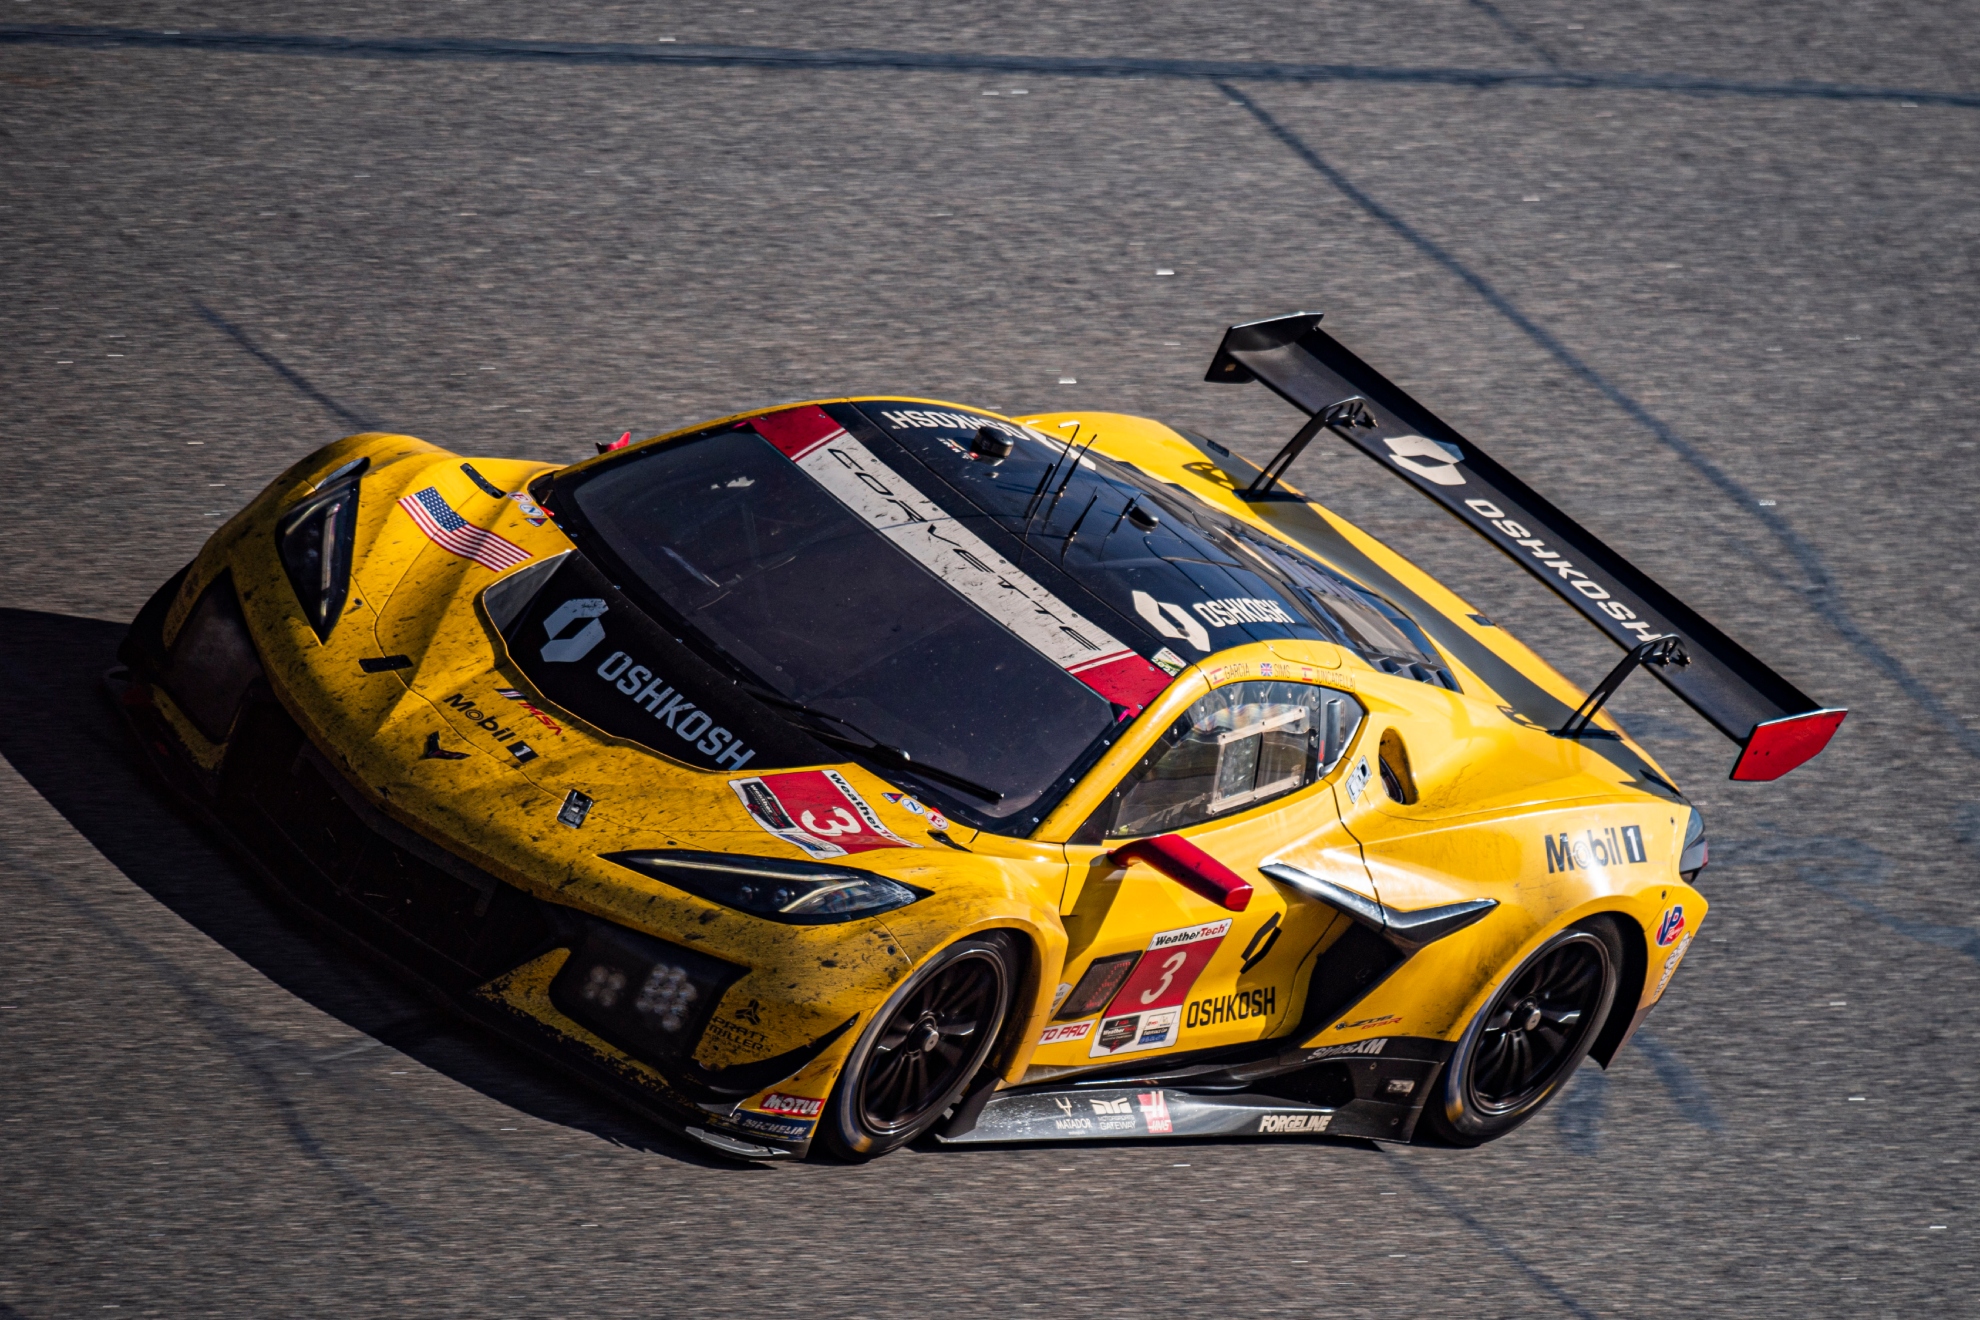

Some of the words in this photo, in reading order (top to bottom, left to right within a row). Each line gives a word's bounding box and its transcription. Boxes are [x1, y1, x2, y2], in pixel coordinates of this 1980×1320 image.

[828, 447, 1103, 652] CORVETTE
[1464, 498, 1663, 642] OSHKOSH
[1192, 597, 1296, 628] OSHKOSH
[1273, 663, 1291, 678] SIMS
[442, 693, 517, 743] Mobil
[597, 650, 757, 771] OSHKOSH
[801, 806, 862, 837] 3
[1544, 827, 1624, 874] Mobil
[1623, 826, 1644, 863] 1
[1155, 924, 1227, 946] WeatherTech
[1140, 951, 1187, 1005] 3
[1186, 986, 1276, 1029] OSHKOSH
[708, 1024, 764, 1051] MILLER
[711, 1015, 769, 1042] PRATT
[1057, 1023, 1091, 1039] PRO
[1307, 1038, 1388, 1060] SiriusXM
[763, 1094, 822, 1115] MOTUL
[742, 1118, 806, 1135] MICHELIN
[1055, 1118, 1093, 1130] MATADOR
[1100, 1120, 1136, 1130] GATEWAY
[1258, 1114, 1333, 1133] FORGELINE
